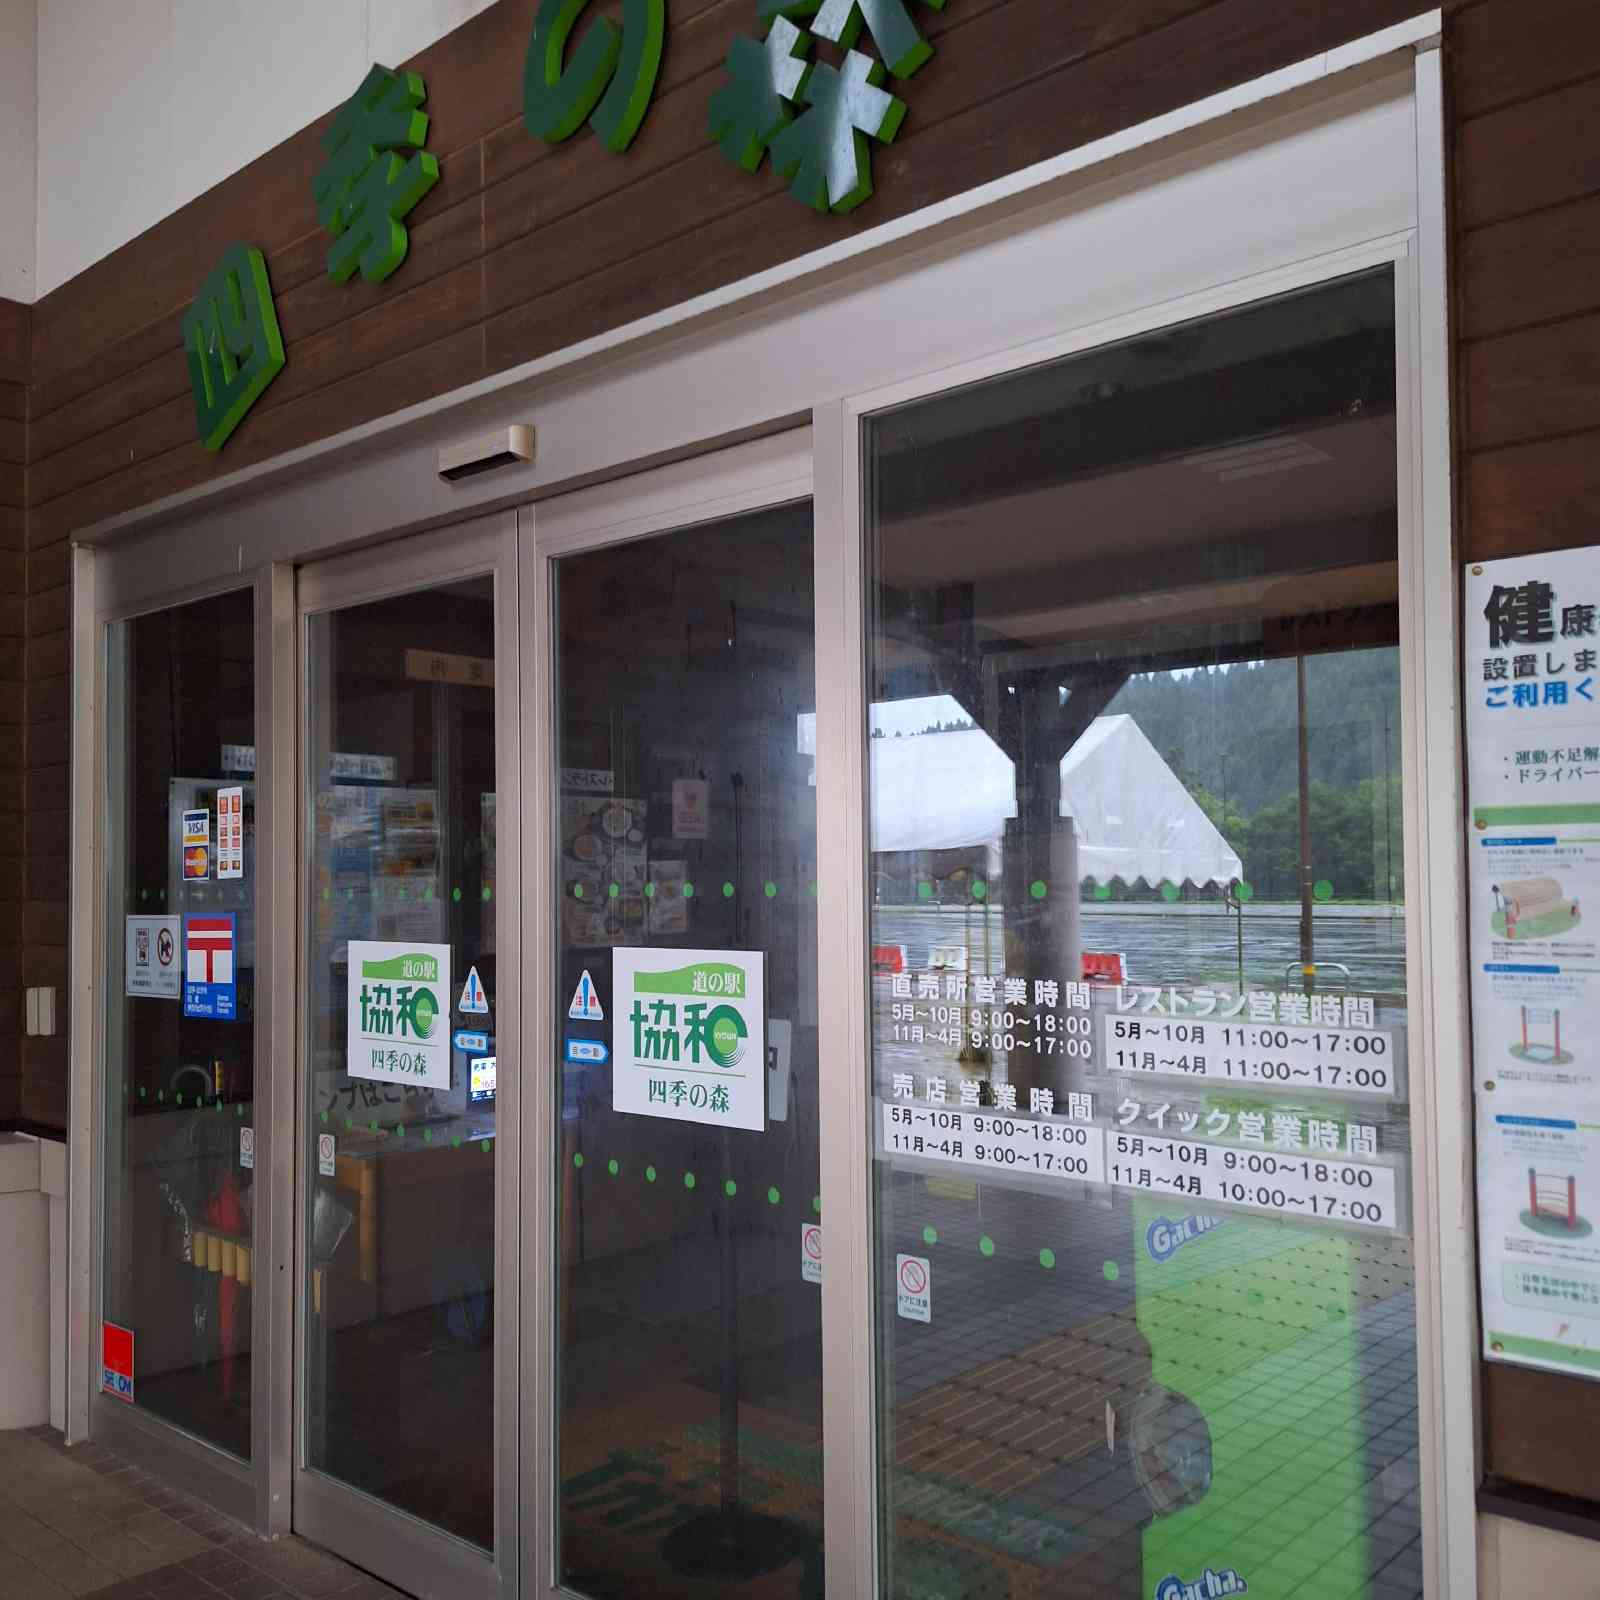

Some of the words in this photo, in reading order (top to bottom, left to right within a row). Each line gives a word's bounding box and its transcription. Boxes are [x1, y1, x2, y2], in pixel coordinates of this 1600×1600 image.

[1484, 580, 1600, 648] 健康
[1483, 649, 1597, 682] 設置しま
[1486, 678, 1594, 708] ご利用く
[188, 822, 204, 834] VISA
[401, 959, 437, 980] 道の駅
[692, 971, 742, 995] 道の駅
[359, 984, 439, 1040] 協和
[891, 973, 1093, 1012] 直売所営業時間
[1114, 984, 1376, 1030] レストラン営業時間
[629, 998, 749, 1068] 協和
[1114, 1021, 1206, 1046] 5月～10月
[1222, 1027, 1387, 1055] 11:00～17:00
[371, 1049, 427, 1076] 四季の森
[1115, 1050, 1207, 1075] 11月～4月
[1223, 1058, 1388, 1088] 11:00～17:00
[647, 1079, 731, 1114] 四季の森
[892, 1072, 1095, 1122] 売店営業時間
[891, 1107, 963, 1132] 5月～10月
[973, 1116, 1088, 1146] 9:00～18:00
[1117, 1098, 1378, 1155] クイック営業時間
[893, 1134, 964, 1159] 11月～4月
[975, 1146, 1089, 1175] 9:00～17:00
[1116, 1137, 1209, 1168] 5月～10月
[1223, 1152, 1374, 1190] 9:00～18:00
[1112, 1164, 1204, 1196] 11月～4月
[1218, 1181, 1383, 1223] 10:00～17:00
